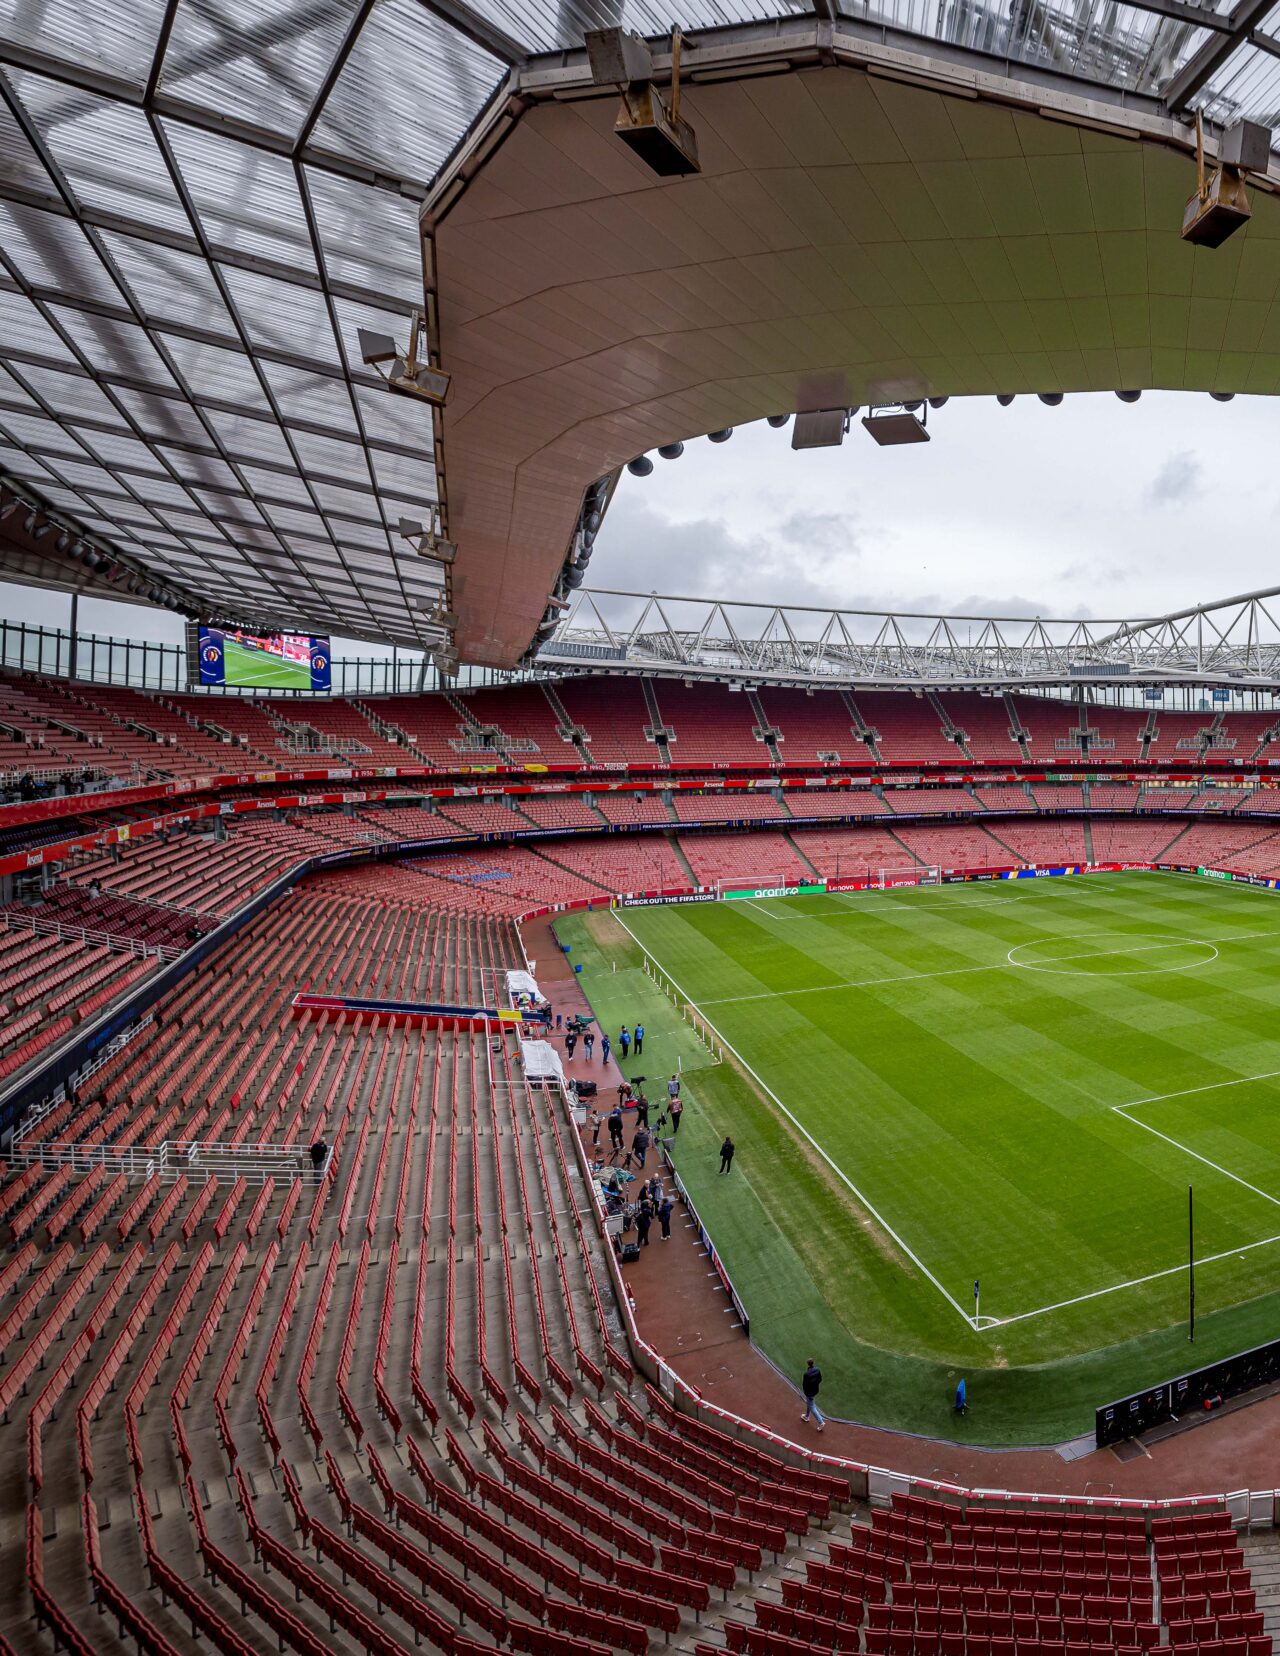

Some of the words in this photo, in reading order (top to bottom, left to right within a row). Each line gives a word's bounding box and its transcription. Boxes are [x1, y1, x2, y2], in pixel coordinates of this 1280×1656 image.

[256, 800, 276, 809] Arsenal
[1035, 869, 1050, 877] VISA
[1203, 869, 1225, 879] aramco
[754, 887, 799, 898] aramco
[694, 894, 714, 902] STORE
